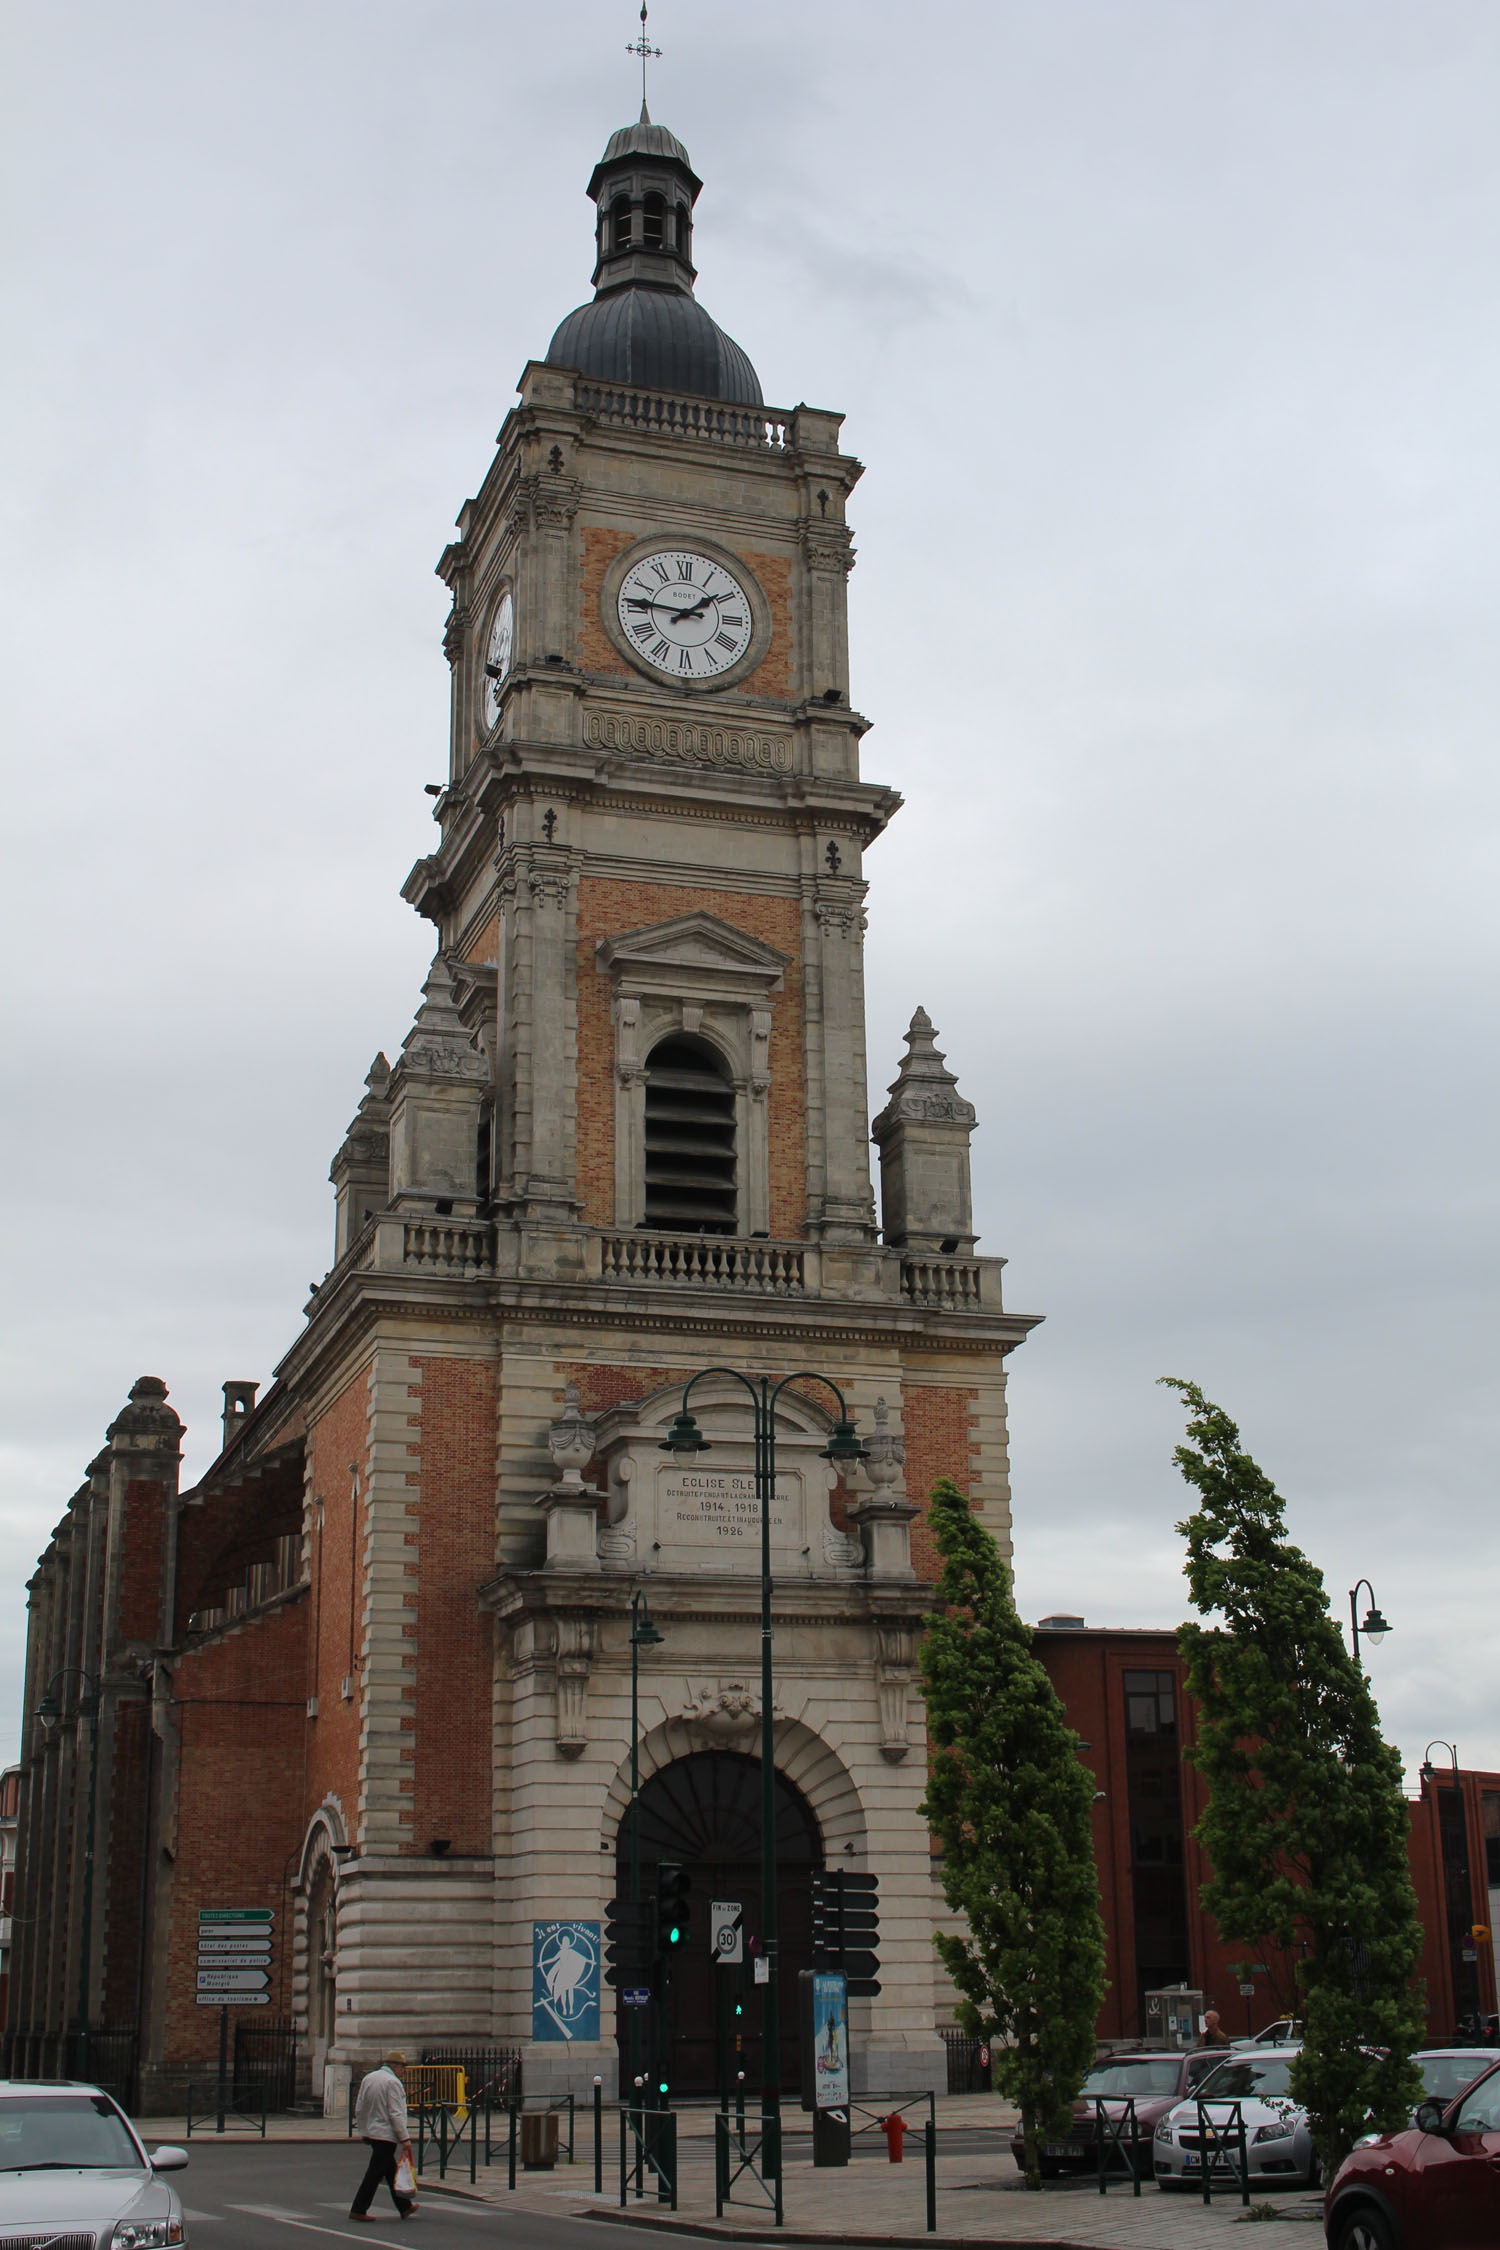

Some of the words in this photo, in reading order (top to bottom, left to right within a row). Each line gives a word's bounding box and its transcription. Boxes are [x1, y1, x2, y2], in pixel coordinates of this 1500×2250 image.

[650, 562, 671, 584] XI
[676, 560, 694, 582] XII
[633, 577, 655, 596] X
[672, 591, 696, 600] BODET
[722, 615, 743, 627] III
[650, 639, 671, 662] VII
[703, 647, 719, 667] V
[679, 649, 693, 670] VI
[700, 1501, 724, 1512] 1914
[735, 1503, 759, 1513] 1918
[716, 1526, 743, 1536] 1926
[713, 1904, 721, 1912] FIN
[727, 1904, 741, 1912] ZONE
[546, 1923, 560, 1933] est
[720, 1933, 733, 1946] 30
